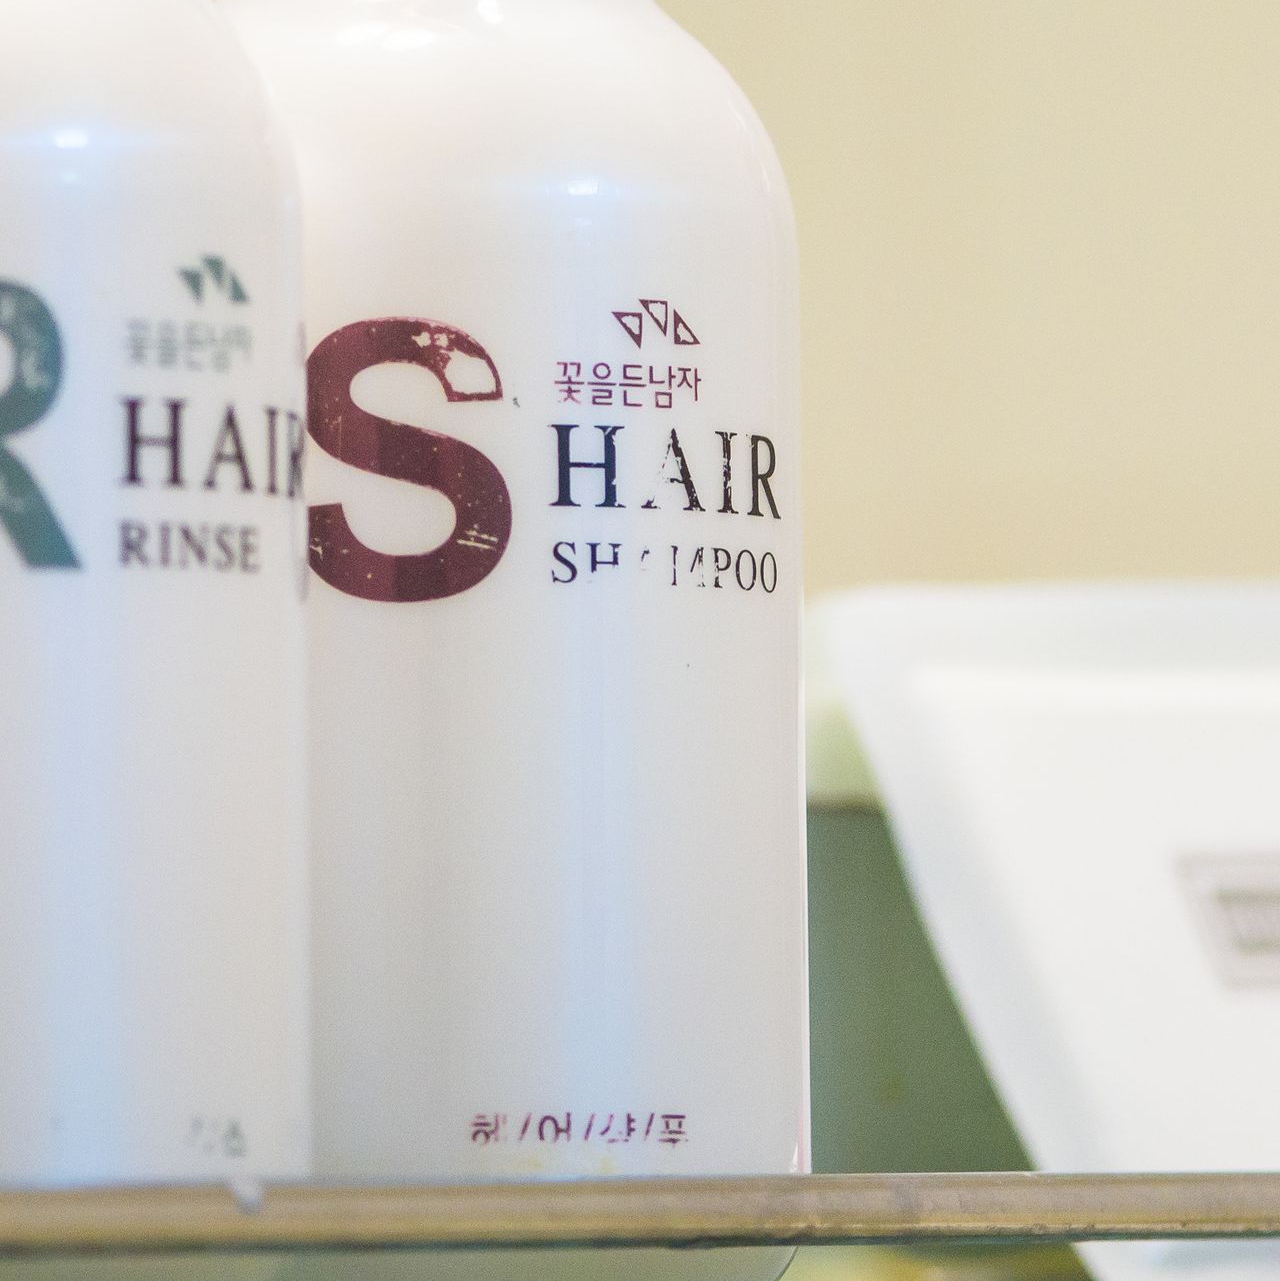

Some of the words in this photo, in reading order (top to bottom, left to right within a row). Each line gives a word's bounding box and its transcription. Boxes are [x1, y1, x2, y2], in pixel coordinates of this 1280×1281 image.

[555, 361, 702, 409] 꽃을든남자
[306, 317, 512, 602] S
[549, 423, 782, 520] HAIR
[120, 520, 259, 573] RINSE
